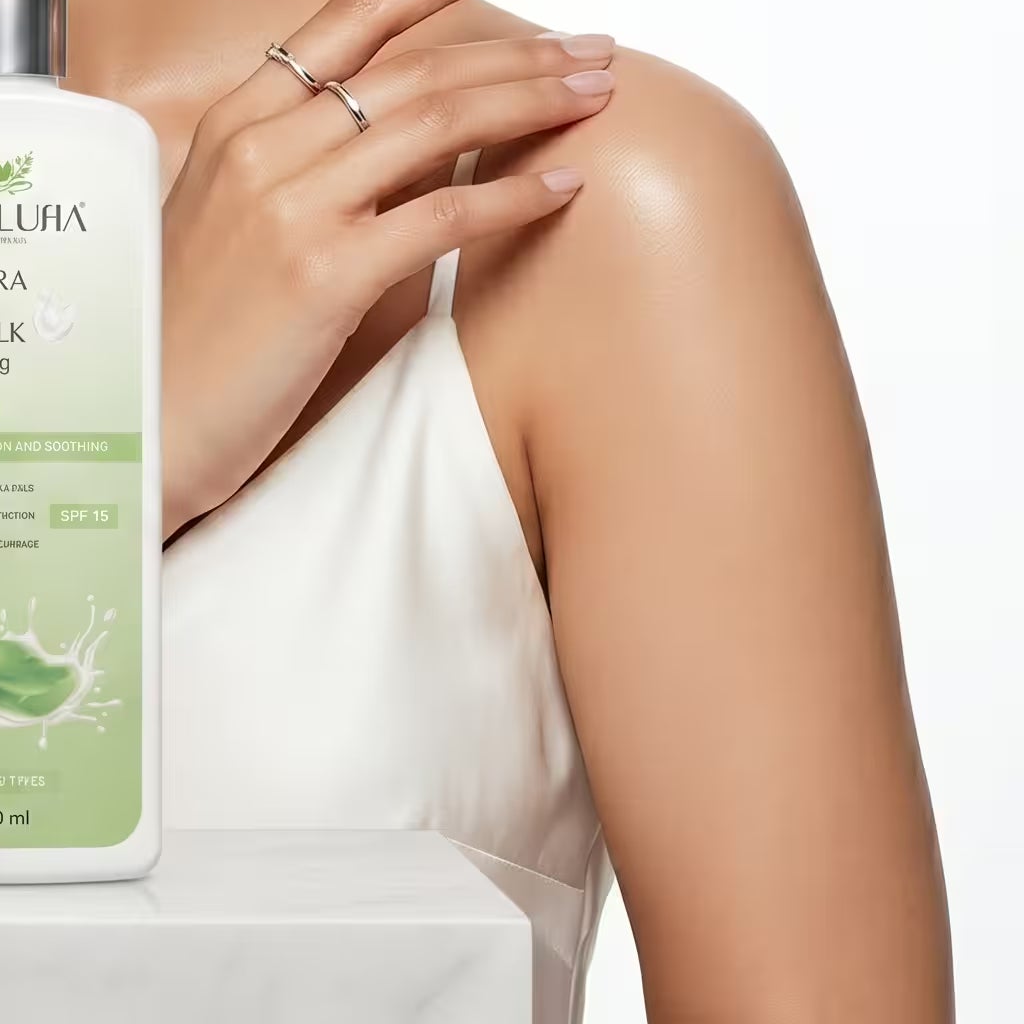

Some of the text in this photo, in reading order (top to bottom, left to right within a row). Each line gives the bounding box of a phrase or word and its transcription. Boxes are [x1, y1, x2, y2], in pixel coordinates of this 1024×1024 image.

[15, 441, 42, 452] AND
[44, 441, 108, 452] SOOTHING
[60, 509, 109, 522] SPF 15
[9, 809, 29, 825] ml
